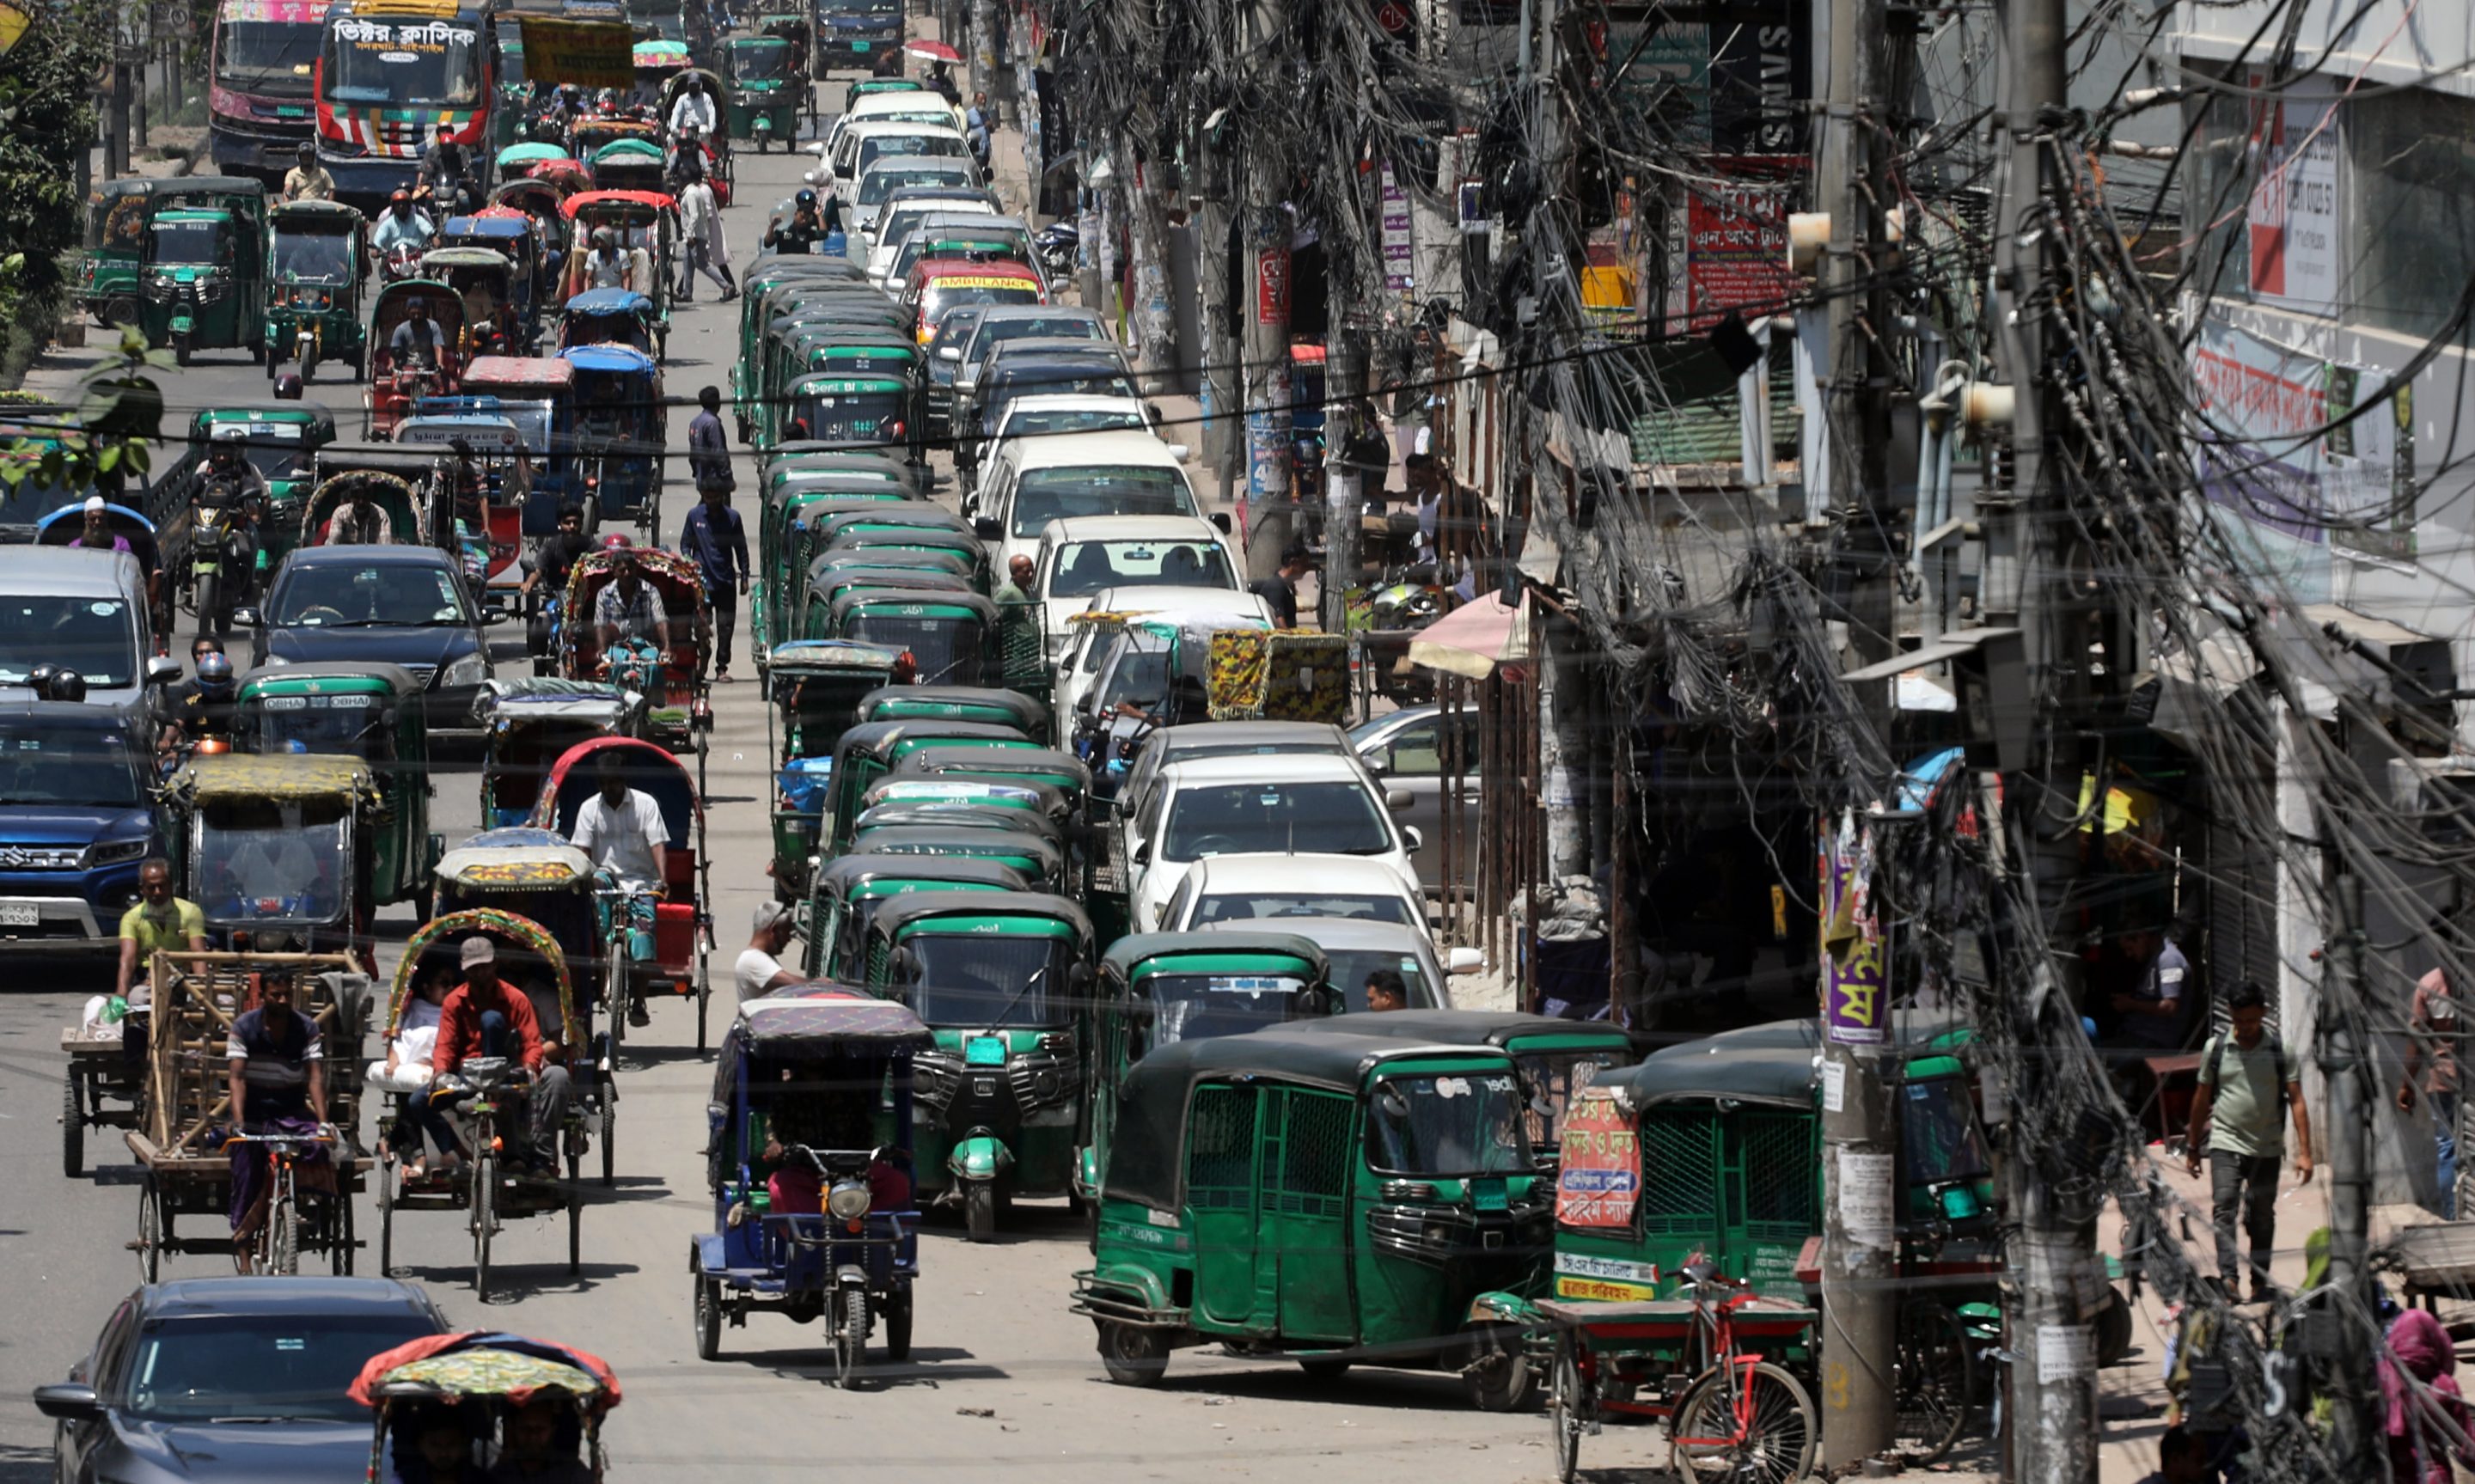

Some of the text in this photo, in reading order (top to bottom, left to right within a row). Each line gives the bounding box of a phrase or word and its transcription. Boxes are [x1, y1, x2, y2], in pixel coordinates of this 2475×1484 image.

[333, 19, 476, 47] ভিক্টর ক্লাসিক
[940, 277, 1029, 287] AMBULANCE
[266, 697, 369, 710] OBHAI OBHAI
[1562, 1131, 1635, 1162] সুন্দর ও দ্রুত
